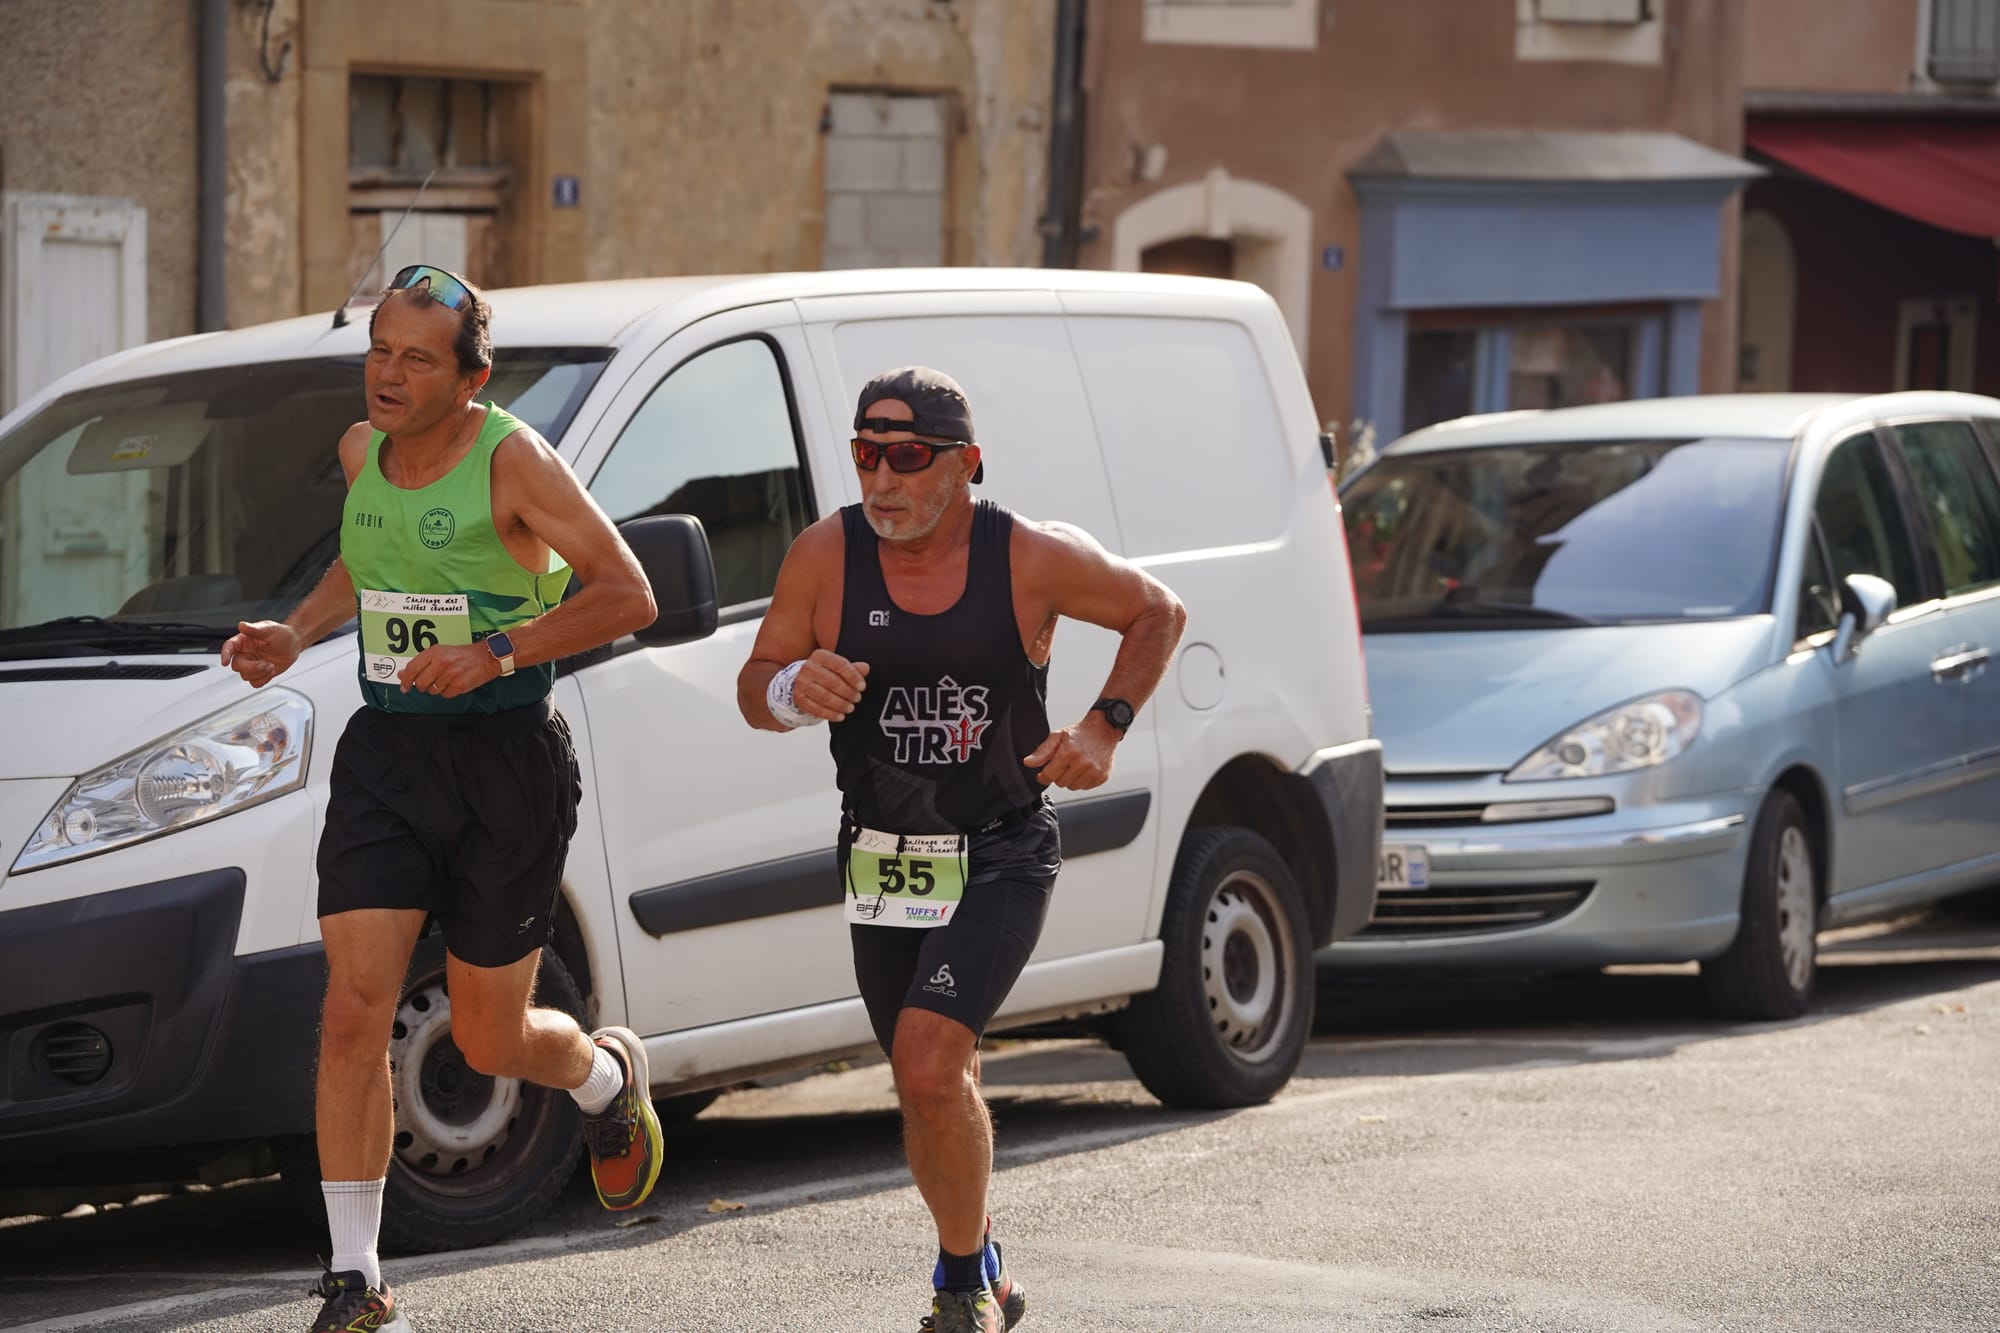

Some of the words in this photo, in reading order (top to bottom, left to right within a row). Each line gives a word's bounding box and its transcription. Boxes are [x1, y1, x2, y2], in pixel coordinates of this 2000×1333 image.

[405, 596, 441, 606] Challenge
[386, 617, 439, 654] 96
[904, 839, 938, 847] hallenge
[878, 858, 936, 896] 55
